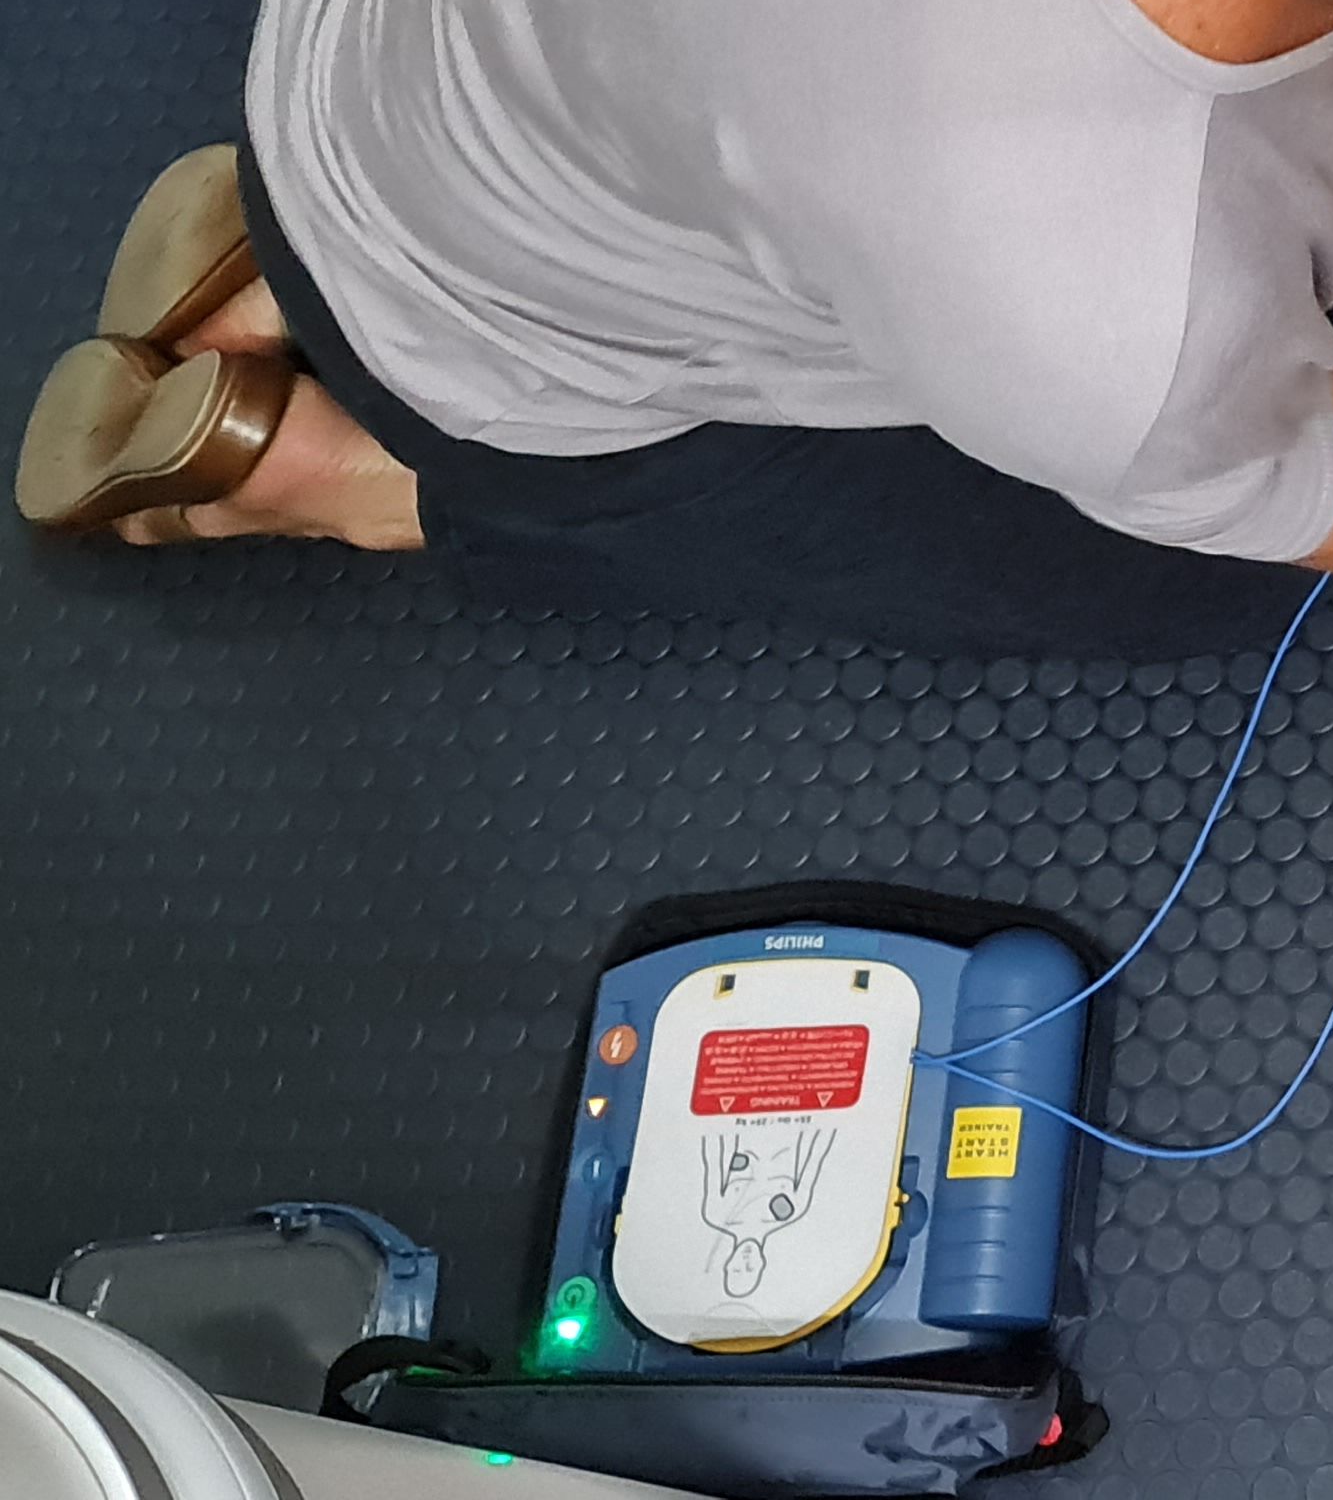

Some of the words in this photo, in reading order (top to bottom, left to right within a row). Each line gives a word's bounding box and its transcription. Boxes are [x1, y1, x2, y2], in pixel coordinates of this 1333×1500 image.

[764, 934, 824, 950] PHILIPS
[749, 1095, 801, 1108] TRAINING
[959, 1124, 1008, 1132] TRAINER
[958, 1138, 1008, 1147] START
[956, 1149, 1008, 1158] HEART
